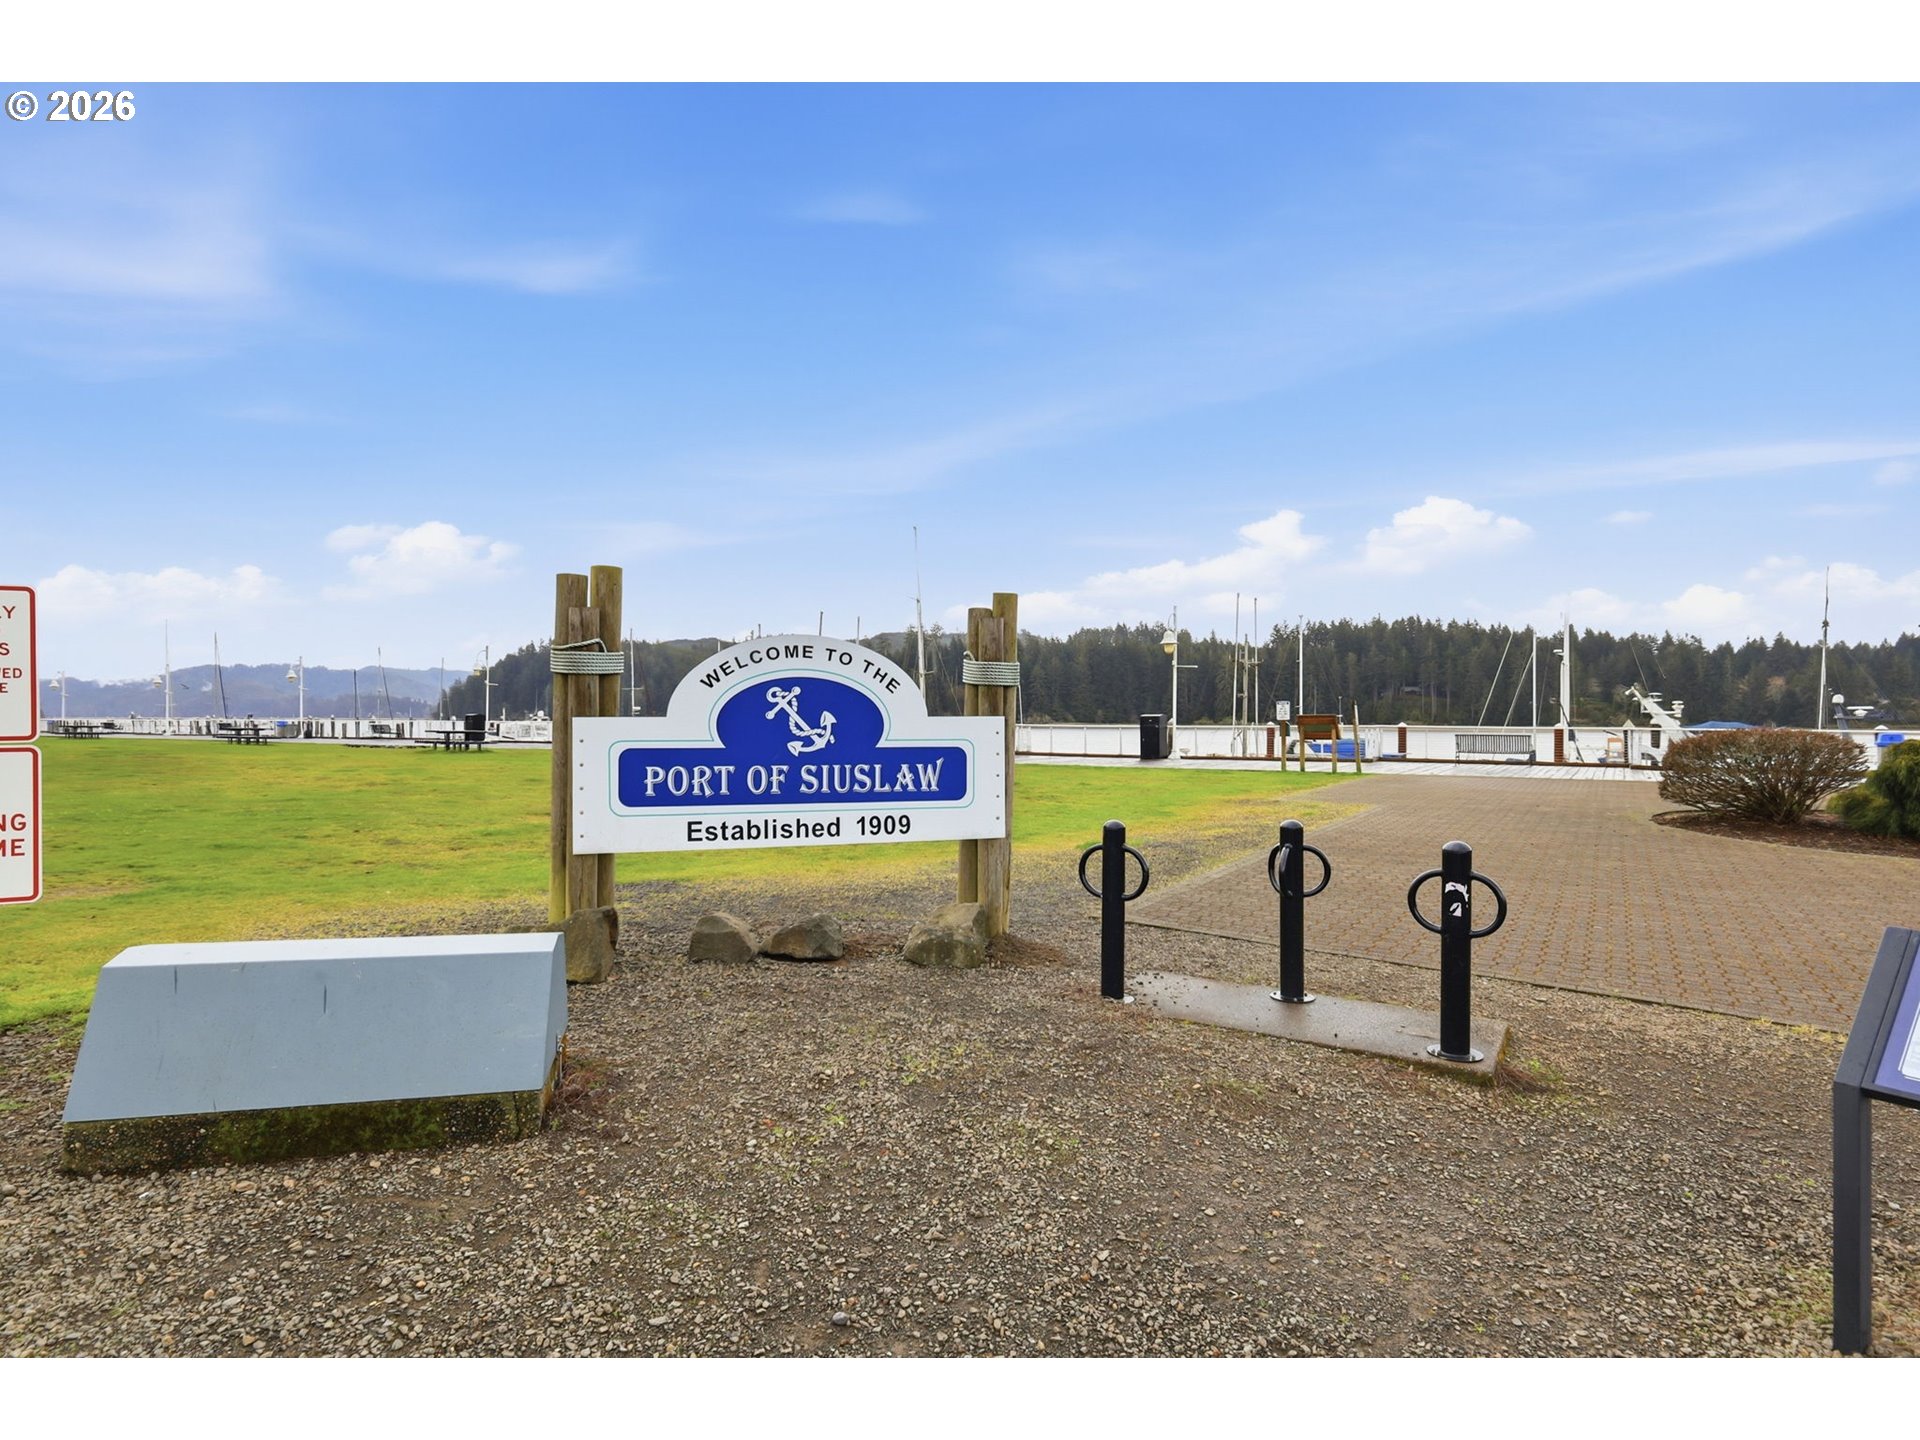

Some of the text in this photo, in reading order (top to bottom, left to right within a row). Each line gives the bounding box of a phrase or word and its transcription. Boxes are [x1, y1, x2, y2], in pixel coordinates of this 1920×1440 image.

[0, 668, 23, 679] ED
[700, 645, 901, 694] WELCOME TO THE
[645, 757, 944, 798] PORT OF SIUSLAW
[686, 814, 911, 842] Established 1909
